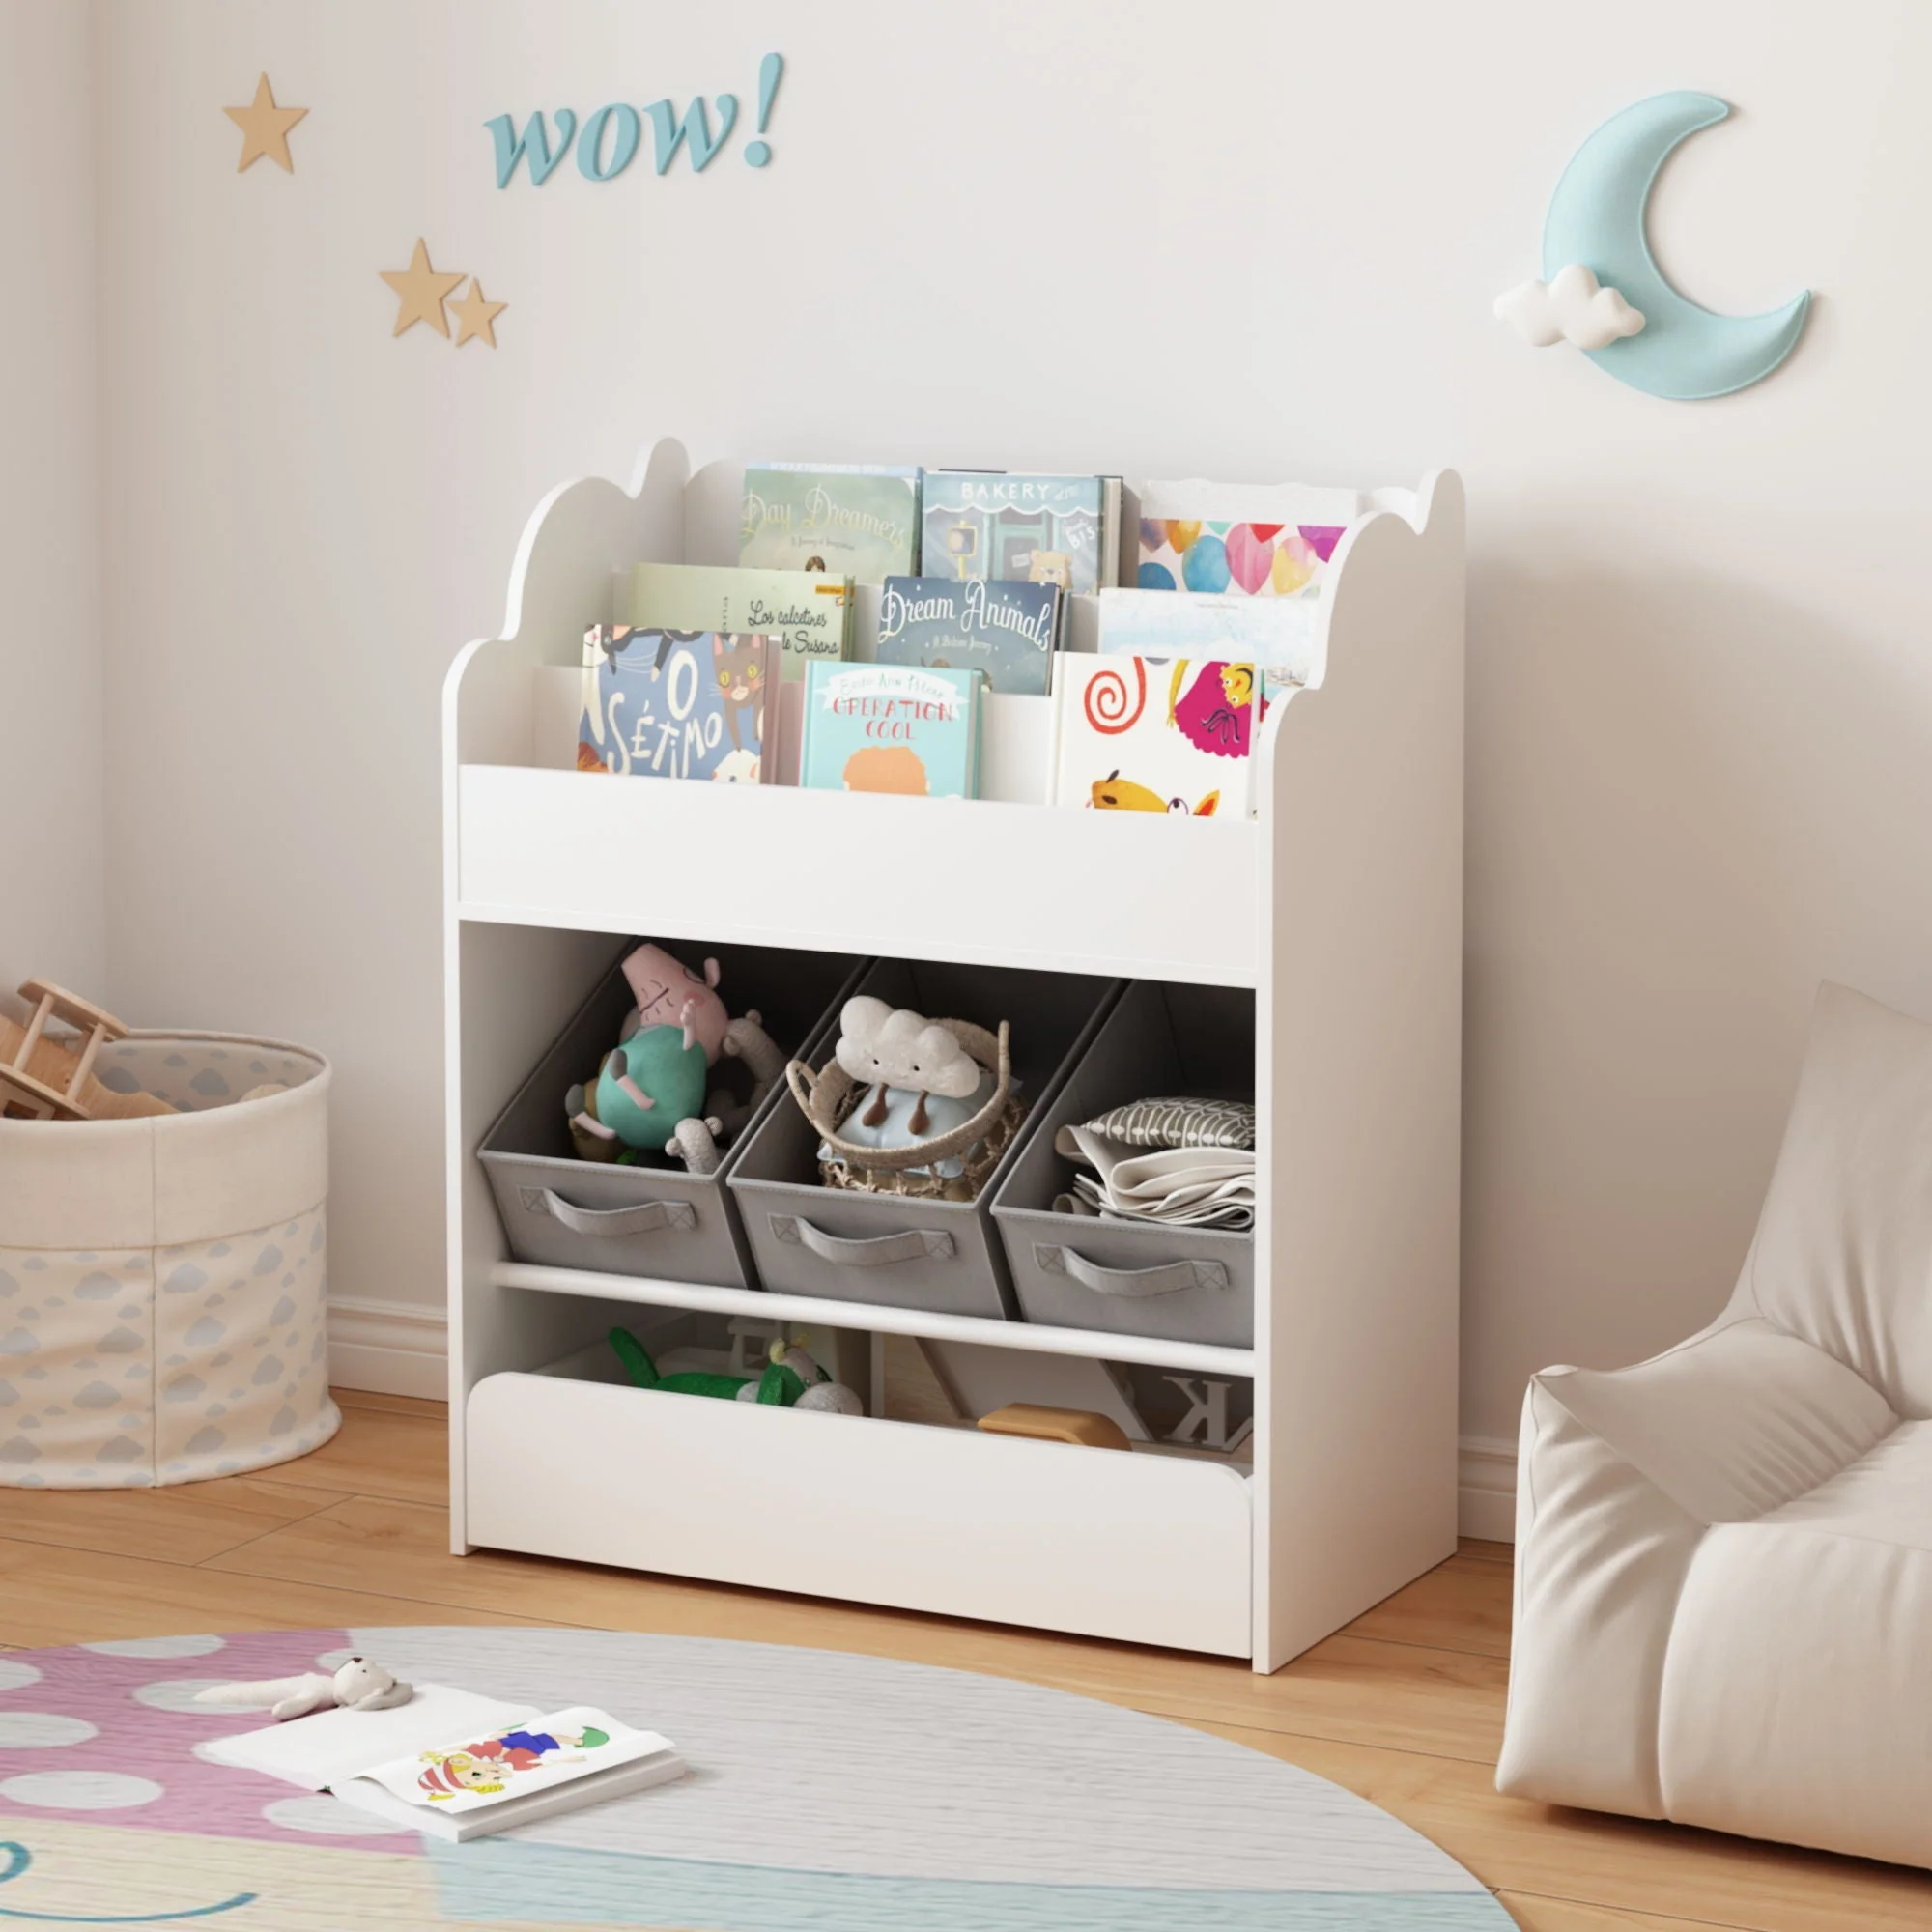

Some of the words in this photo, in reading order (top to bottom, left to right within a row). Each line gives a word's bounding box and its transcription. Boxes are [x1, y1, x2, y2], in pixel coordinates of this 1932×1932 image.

[483, 52, 784, 189] wow!
[961, 482, 1049, 500] BAKERY
[740, 487, 791, 538] Day
[748, 599, 774, 627] Los
[777, 604, 828, 627] calcetines
[878, 583, 956, 644] Dream
[960, 580, 1051, 652] Animals
[794, 630, 839, 654] Susana
[667, 649, 699, 721] O
[833, 695, 954, 722] OPERATION
[866, 720, 915, 741] COOL
